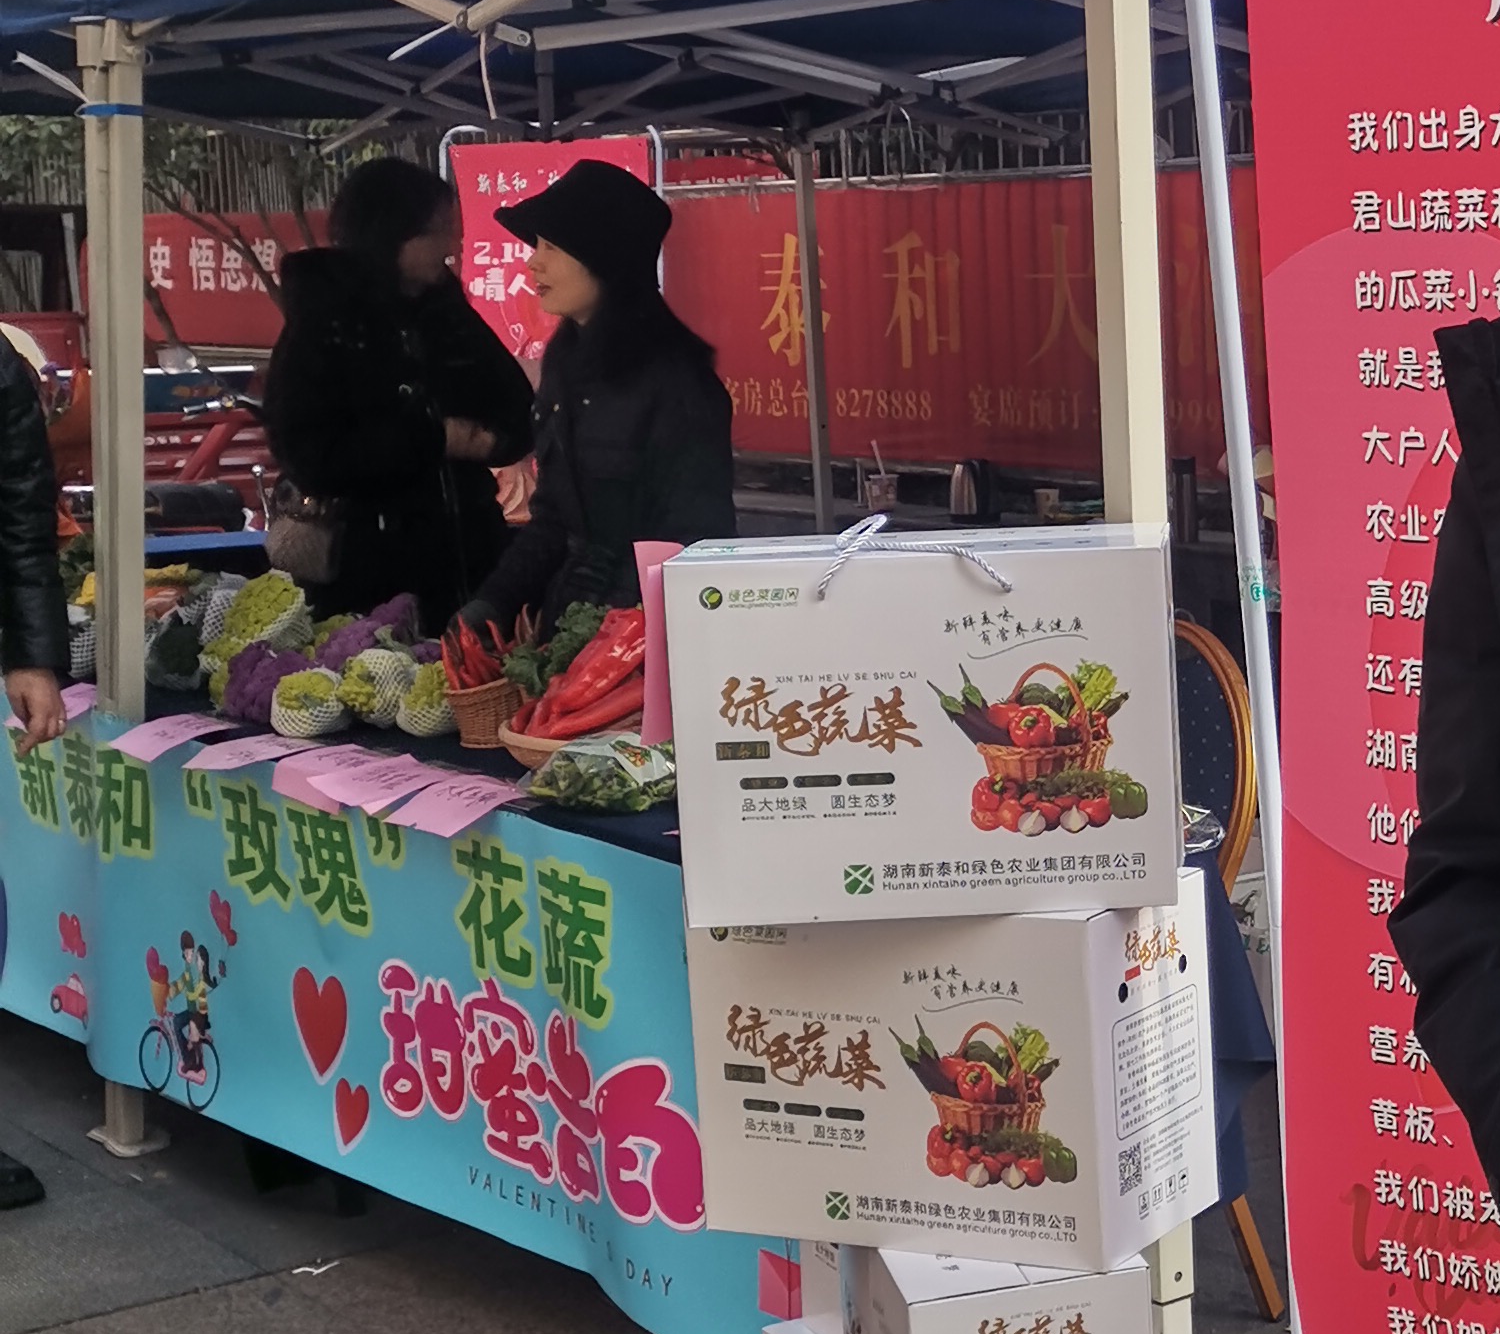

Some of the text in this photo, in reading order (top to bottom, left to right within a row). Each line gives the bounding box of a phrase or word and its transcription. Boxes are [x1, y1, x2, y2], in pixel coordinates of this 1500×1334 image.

[473, 242, 533, 265] 2.14
[469, 268, 536, 302] 情人
[835, 388, 932, 420] 8278888
[1362, 424, 1459, 465] 大户人
[1366, 578, 1429, 619] 高级
[775, 676, 793, 684] XIN
[819, 674, 832, 682] HE
[838, 673, 849, 681] LV
[855, 673, 868, 681] SE
[900, 671, 917, 679] CAI
[719, 676, 923, 756] 绿色蔬菜
[742, 793, 897, 812] 品大地绿 圆生态梦
[883, 853, 1146, 879] 湖南新泰和绿色农业集团有限公司
[883, 880, 919, 891] Hunan
[969, 877, 1001, 889] green
[1005, 873, 1065, 888] agriculture
[1067, 873, 1099, 886] group
[726, 1004, 886, 1091] 绿色蔬菜
[1369, 1025, 1431, 1070] 营养
[856, 1195, 1076, 1231] 湖南新泰和绿色农业集团有限公司
[927, 1219, 954, 1230] green
[1009, 1227, 1036, 1240] group
[626, 1257, 673, 1297] DAY
